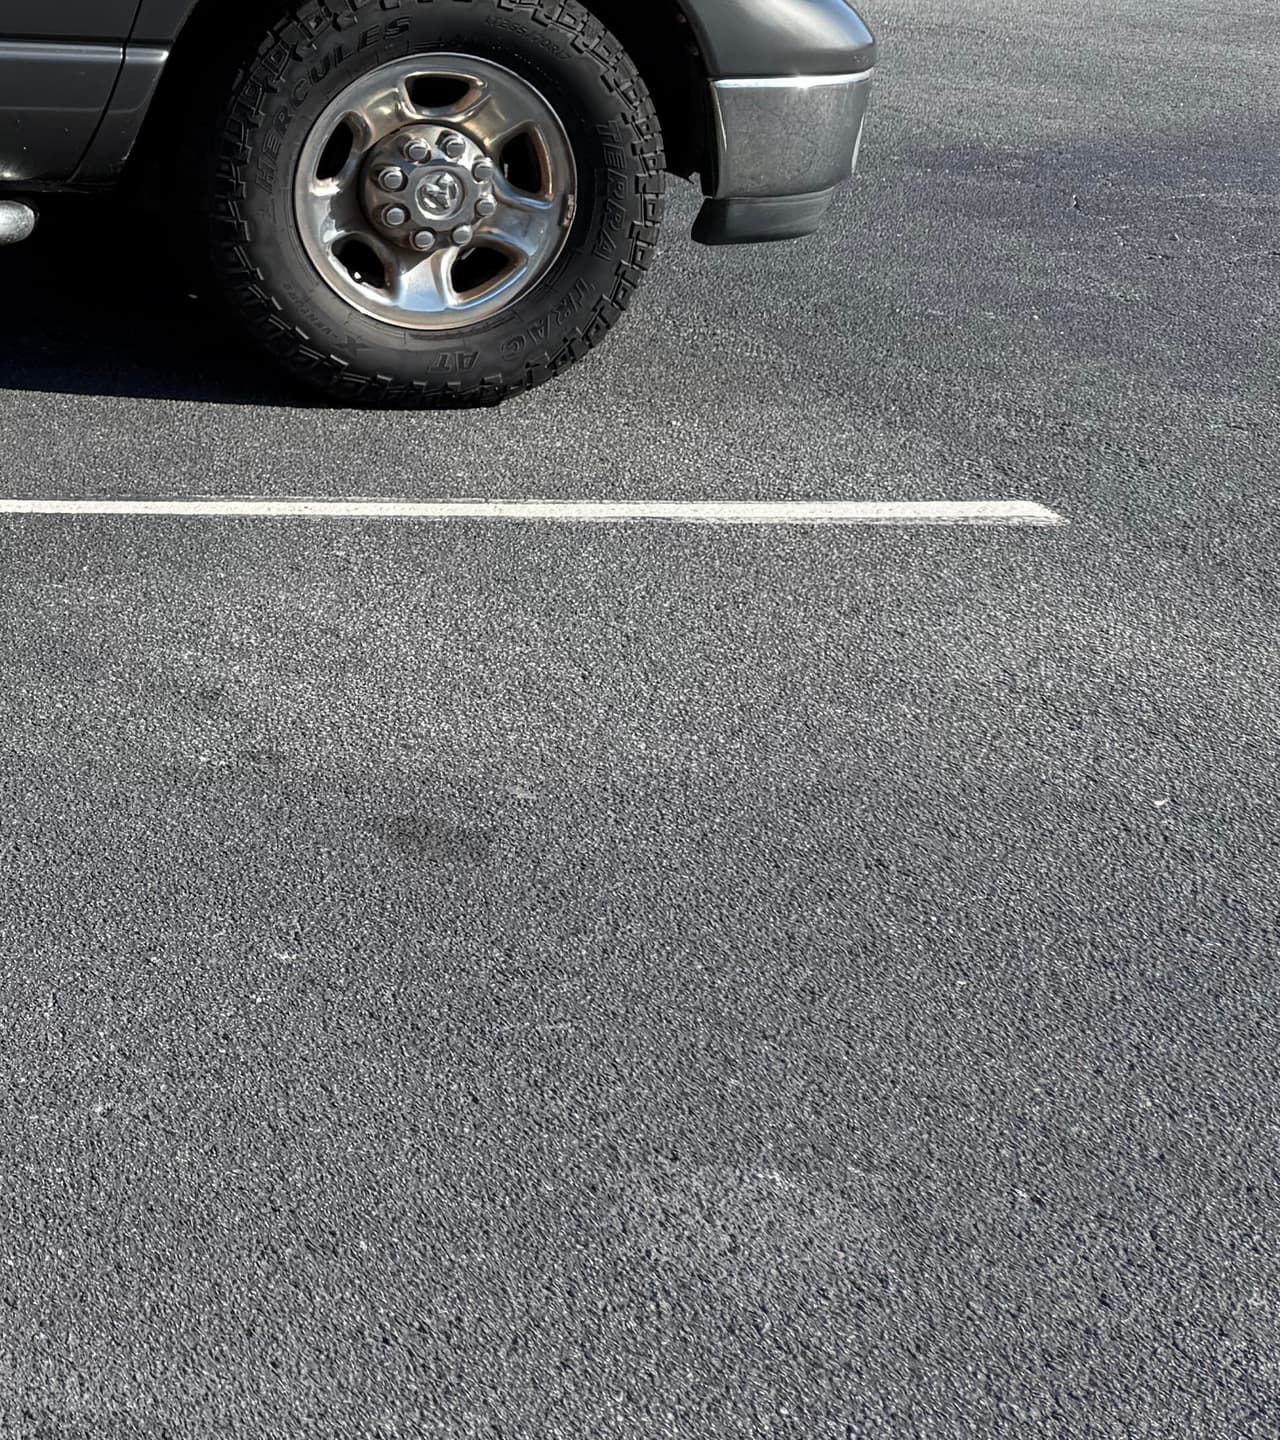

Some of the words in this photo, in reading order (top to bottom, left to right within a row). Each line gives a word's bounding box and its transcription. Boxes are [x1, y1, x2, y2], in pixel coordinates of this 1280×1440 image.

[255, 15, 414, 195] HERCULES
[593, 120, 628, 262] TERRA
[426, 350, 481, 375] AT
[500, 277, 598, 359] TRAC
